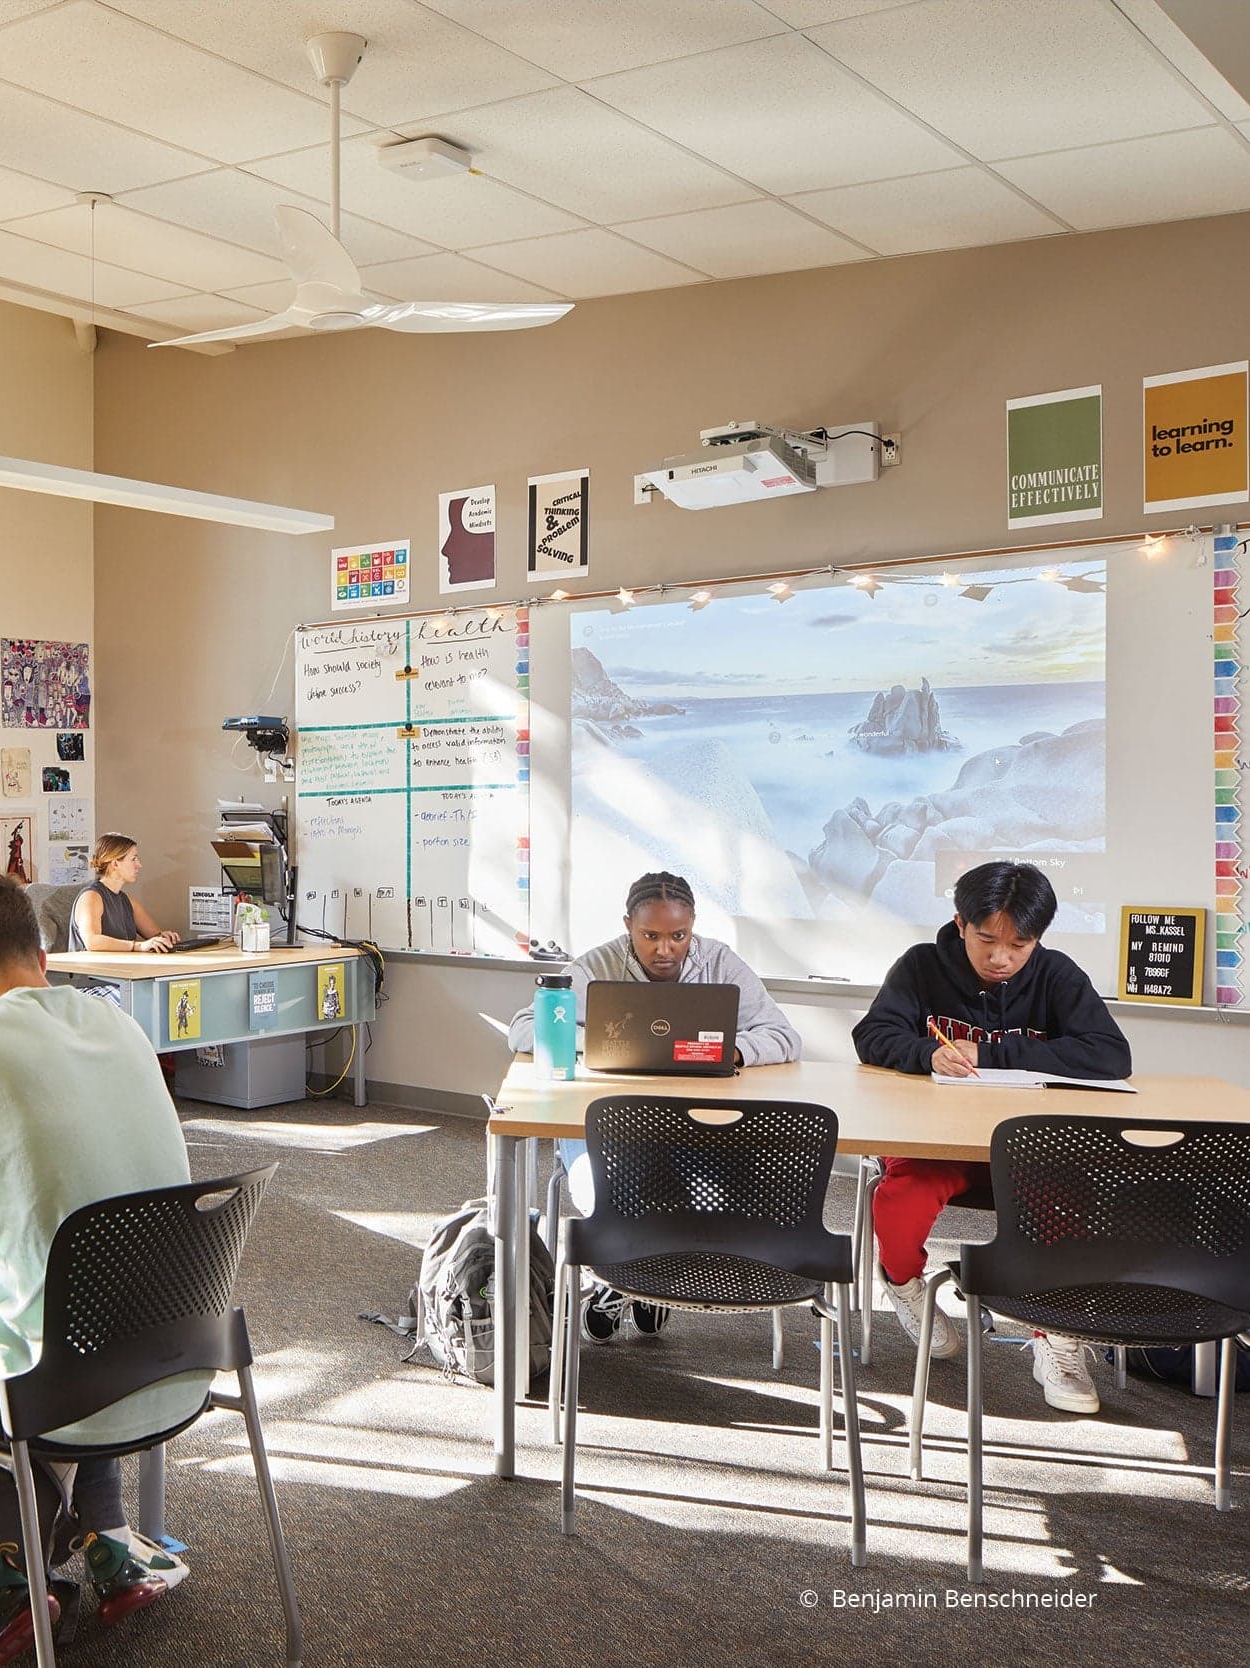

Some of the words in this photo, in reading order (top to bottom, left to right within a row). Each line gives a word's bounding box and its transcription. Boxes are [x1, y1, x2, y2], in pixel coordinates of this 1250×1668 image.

[1152, 418, 1234, 441] learning
[1152, 445, 1171, 458] to
[1176, 437, 1234, 454] learn.
[691, 464, 718, 475] HITACHI
[1011, 464, 1099, 490] COMMUNICATE
[471, 497, 491, 507] Develop
[552, 491, 582, 507] CRITICAL
[1011, 482, 1100, 508] EFFECTIVELY
[469, 508, 492, 518] Academic
[544, 507, 580, 517] THINKING
[469, 519, 492, 529] Mindsets
[546, 515, 559, 531] &
[541, 516, 580, 547] PROBLEM
[536, 544, 574, 564] SOLVING
[417, 617, 513, 640] health
[349, 628, 402, 655] history
[421, 655, 439, 668] How
[445, 652, 453, 664] is
[458, 648, 490, 661] health
[304, 664, 320, 677] How
[356, 659, 382, 678] society
[330, 681, 362, 698] success?
[425, 677, 454, 692] relevant
[456, 673, 466, 684] to
[423, 728, 465, 738] Demonstrate
[469, 726, 480, 735] the
[482, 726, 504, 738] ability
[412, 742, 420, 751] to
[446, 739, 466, 748] valid
[413, 759, 422, 768] to
[453, 837, 470, 847] size
[1014, 857, 1048, 866] Bottom
[1050, 857, 1066, 868] Sky
[1131, 915, 1159, 925] FOLLOW
[1164, 916, 1176, 925] ME
[1131, 942, 1143, 951] MY
[1152, 942, 1184, 953] REMIND
[1149, 953, 1171, 963] 81010
[253, 992, 275, 1005] REJECT
